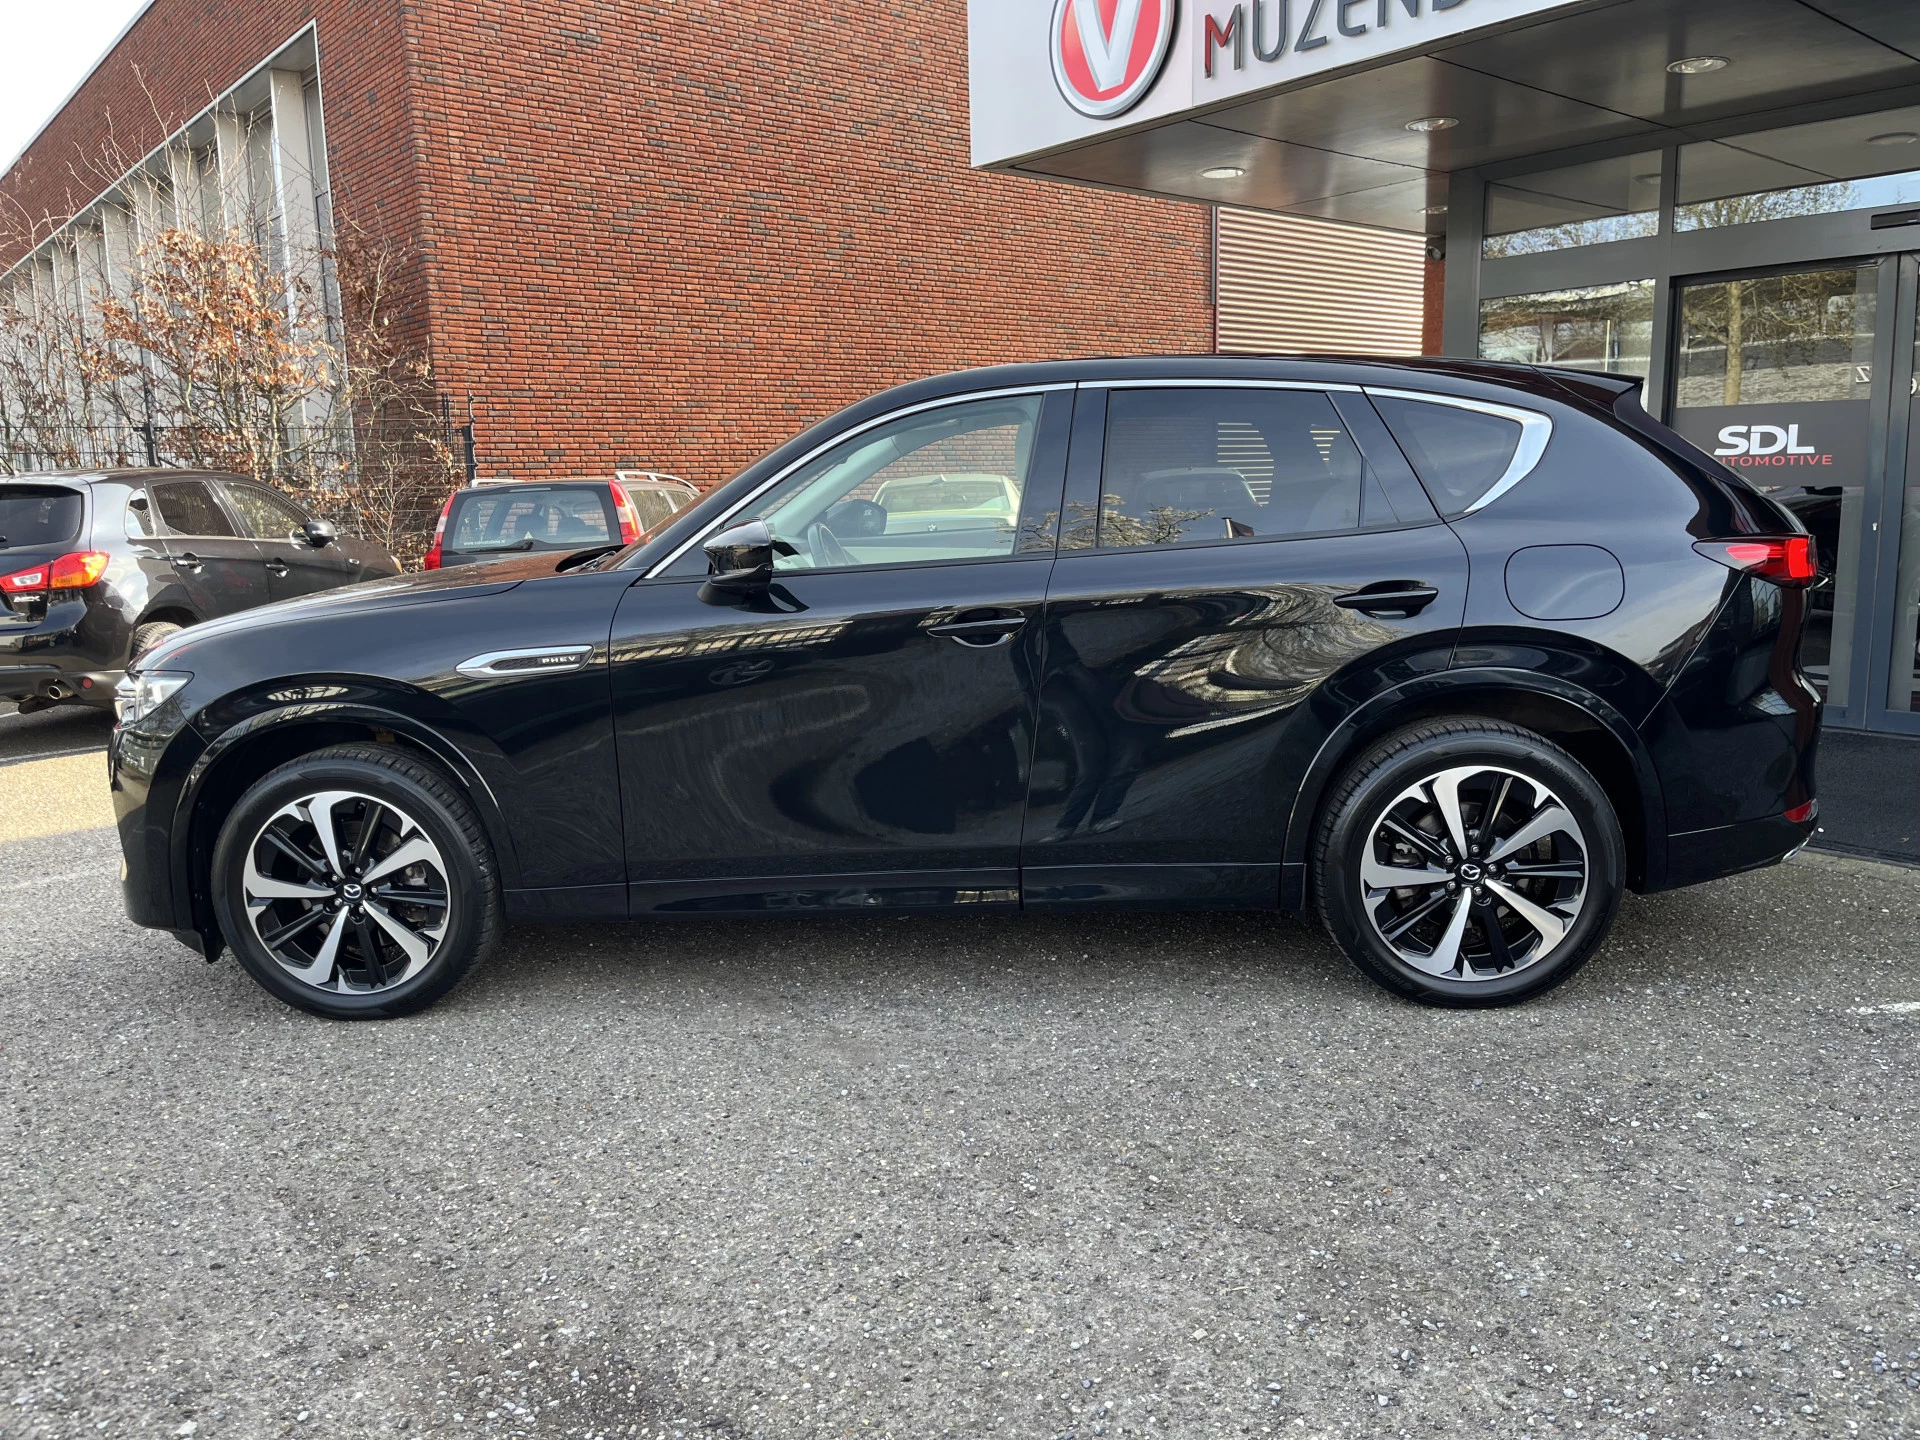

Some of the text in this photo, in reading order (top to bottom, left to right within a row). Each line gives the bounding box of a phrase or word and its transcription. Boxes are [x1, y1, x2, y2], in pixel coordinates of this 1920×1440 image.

[1204, 0, 1464, 79] MUZE
[1714, 424, 1815, 455] SDL
[1722, 455, 1832, 467] TOMOTIVE
[542, 656, 576, 664] PHEV
